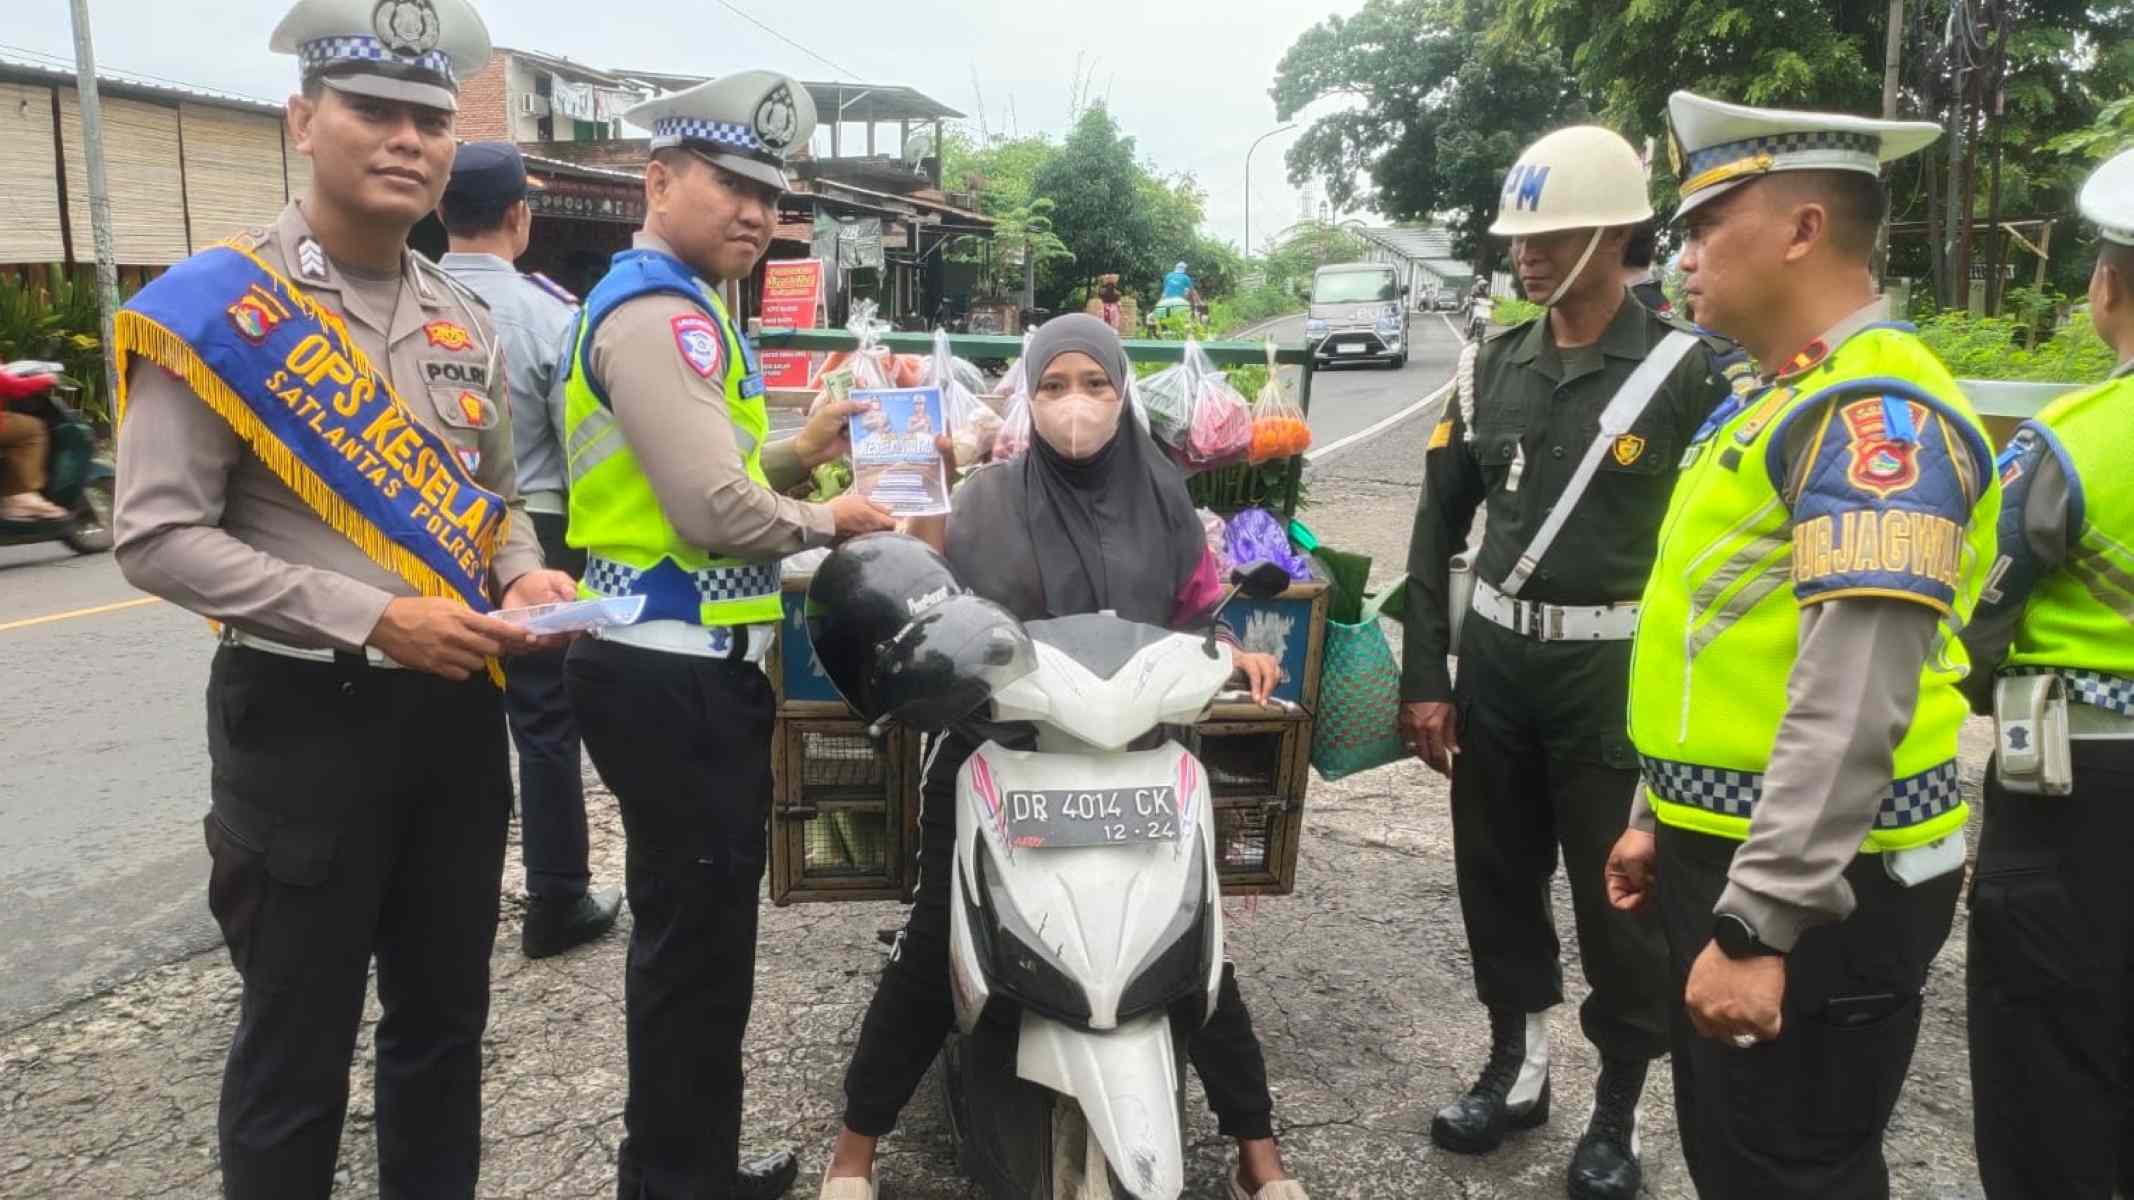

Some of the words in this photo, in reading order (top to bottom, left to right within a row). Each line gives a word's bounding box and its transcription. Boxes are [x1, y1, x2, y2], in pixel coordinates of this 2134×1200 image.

[426, 363, 485, 385] POLRI
[265, 371, 402, 498] SATLANTAS
[410, 502, 480, 579] POLRES
[286, 334, 375, 417] OPS
[362, 407, 497, 548] KESELA
[1012, 793, 1049, 822] DR
[1062, 792, 1122, 819] 4014
[1135, 789, 1174, 816] CK
